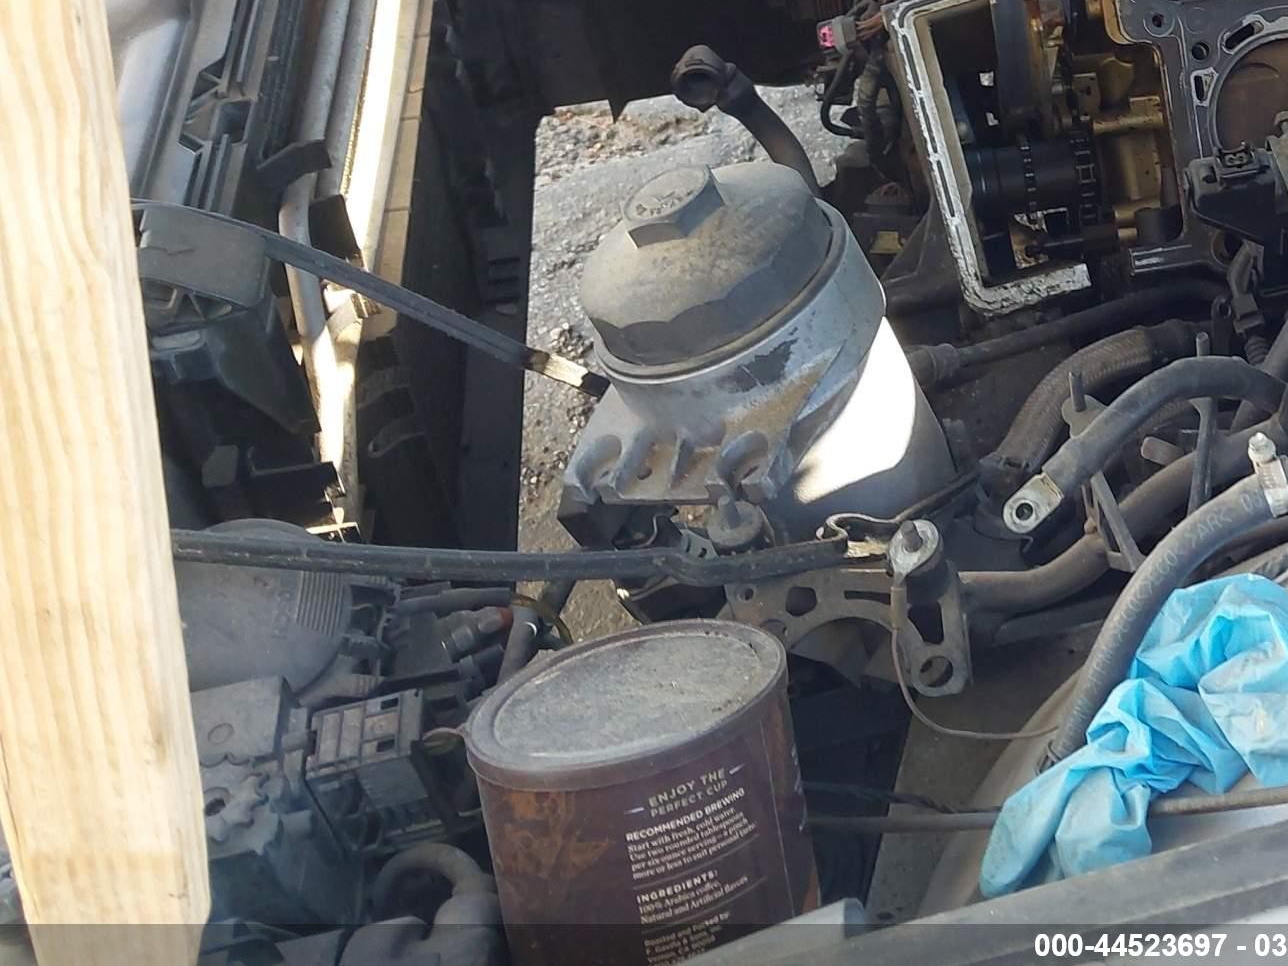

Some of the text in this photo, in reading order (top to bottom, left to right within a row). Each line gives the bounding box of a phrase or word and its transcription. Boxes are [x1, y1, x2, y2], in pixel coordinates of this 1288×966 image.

[648, 768, 726, 808] ENJOY THE
[650, 779, 728, 818] PERFECT CUP
[625, 787, 746, 842] RECOMMENDED BREWING
[628, 841, 651, 853] Start
[650, 835, 671, 848] with
[695, 816, 713, 831] cold
[665, 832, 701, 852] rounded
[631, 860, 648, 873] per
[660, 849, 687, 863] ounce
[632, 869, 655, 881] more
[666, 859, 683, 872] less
[692, 847, 709, 862] suit
[636, 869, 718, 904] INGREDIENTS:
[664, 890, 696, 907] Arabica
[640, 908, 673, 925] Natural
[673, 902, 690, 915] and
[690, 886, 725, 909] Artificial
